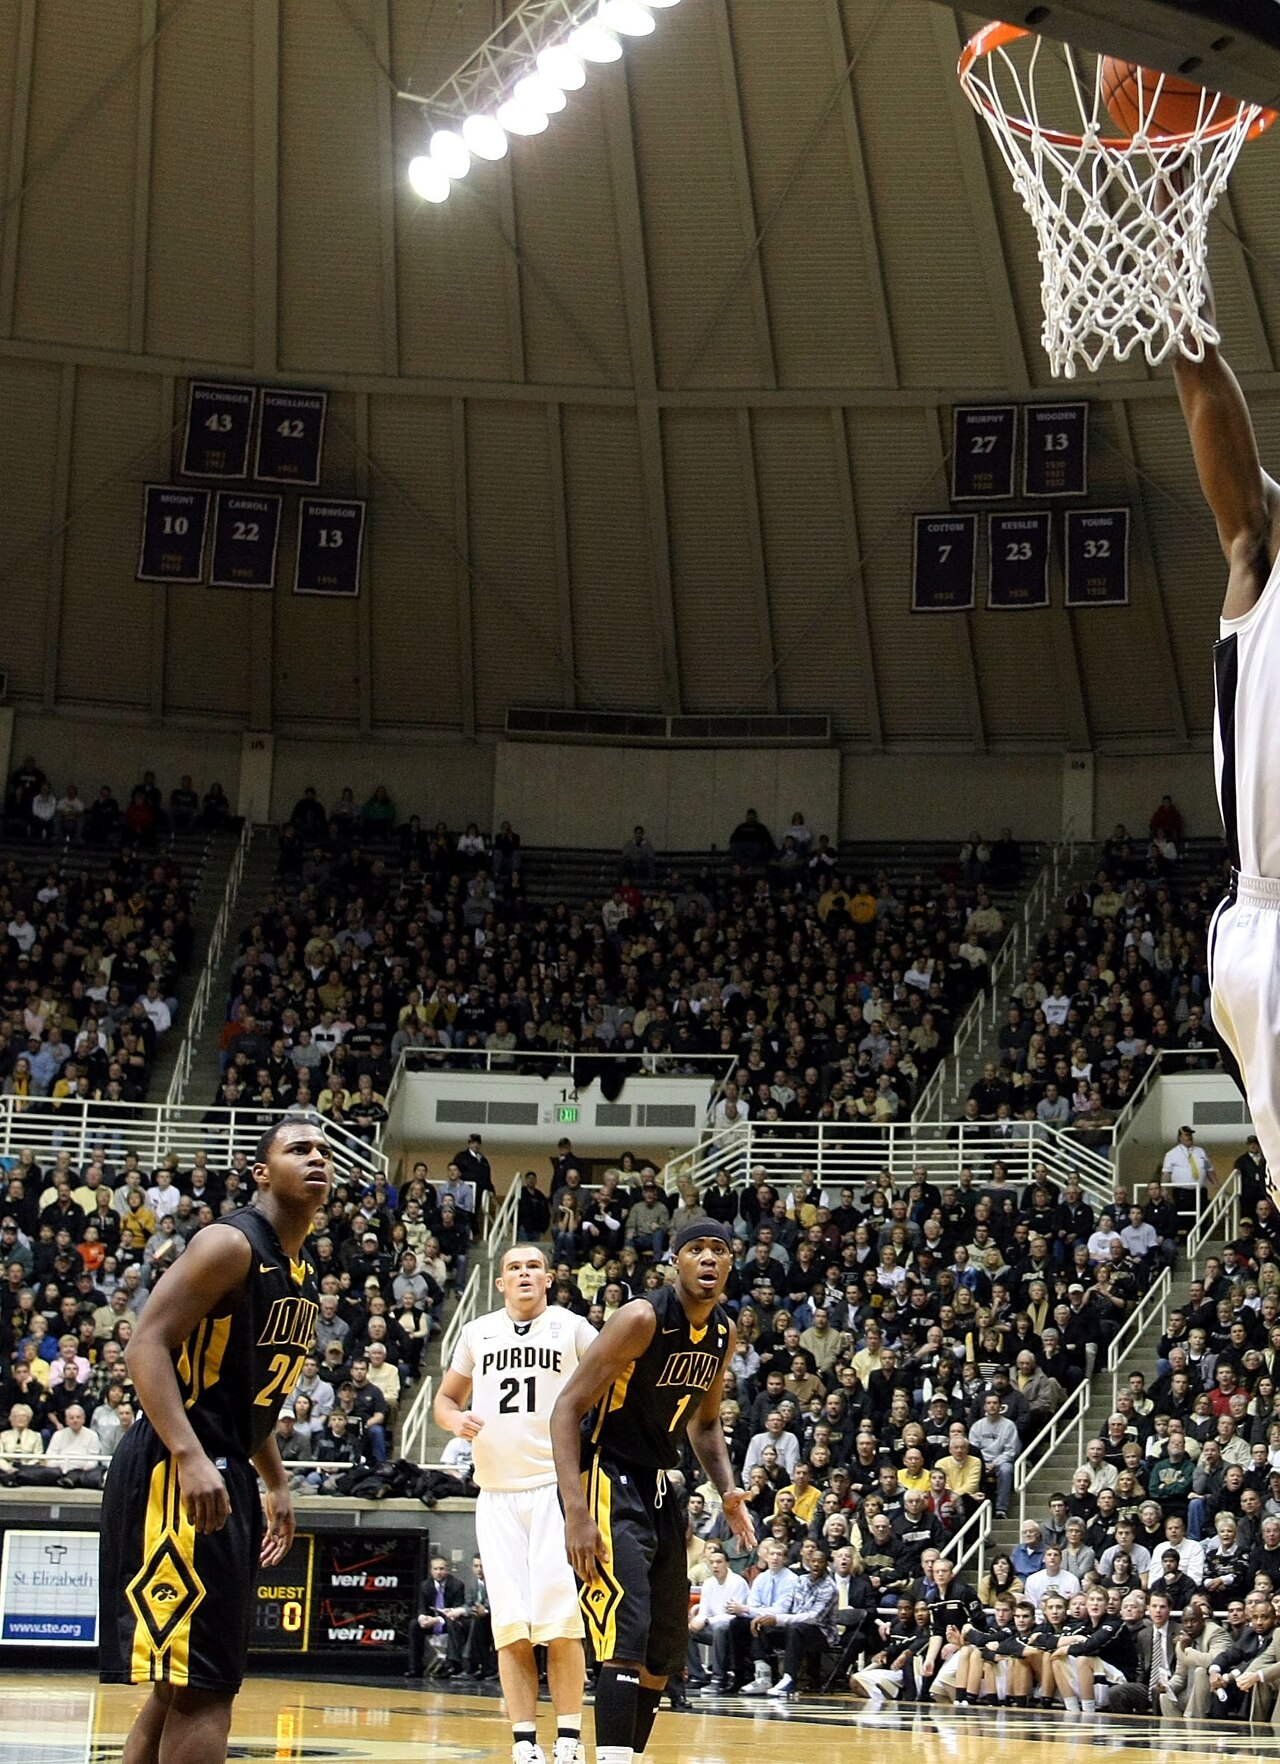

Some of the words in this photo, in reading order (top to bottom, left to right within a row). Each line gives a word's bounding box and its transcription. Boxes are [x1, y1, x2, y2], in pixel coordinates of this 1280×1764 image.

[205, 413, 233, 432] 43
[1036, 411, 1077, 421] WOODEN
[276, 419, 304, 438] 42
[970, 435, 998, 454] 27
[1044, 433, 1069, 452] 13
[161, 494, 194, 506] MOUNT
[228, 500, 268, 512] CARROLL
[309, 506, 356, 518] ROBINSON
[162, 516, 189, 535] 10
[232, 522, 260, 542] 22
[1001, 520, 1039, 530] KESSLER
[1081, 518, 1115, 528] YOUNG
[319, 529, 343, 548] 13
[938, 544, 953, 564] 7
[1005, 542, 1032, 561] 23
[1083, 539, 1111, 559] 32
[560, 1089, 578, 1102] 14
[483, 1347, 561, 1375] PURDUE
[253, 1354, 306, 1407] 24
[656, 1351, 720, 1391] IOWA
[500, 1377, 536, 1414] 21
[669, 1394, 691, 1432] 1
[32, 1571, 93, 1587] Elizabeth
[331, 1572, 398, 1590] verizon
[257, 1586, 304, 1599] GUEST
[283, 1601, 302, 1631] 0
[9, 1623, 81, 1636] www.ste.org
[328, 1625, 395, 1644] verizon
